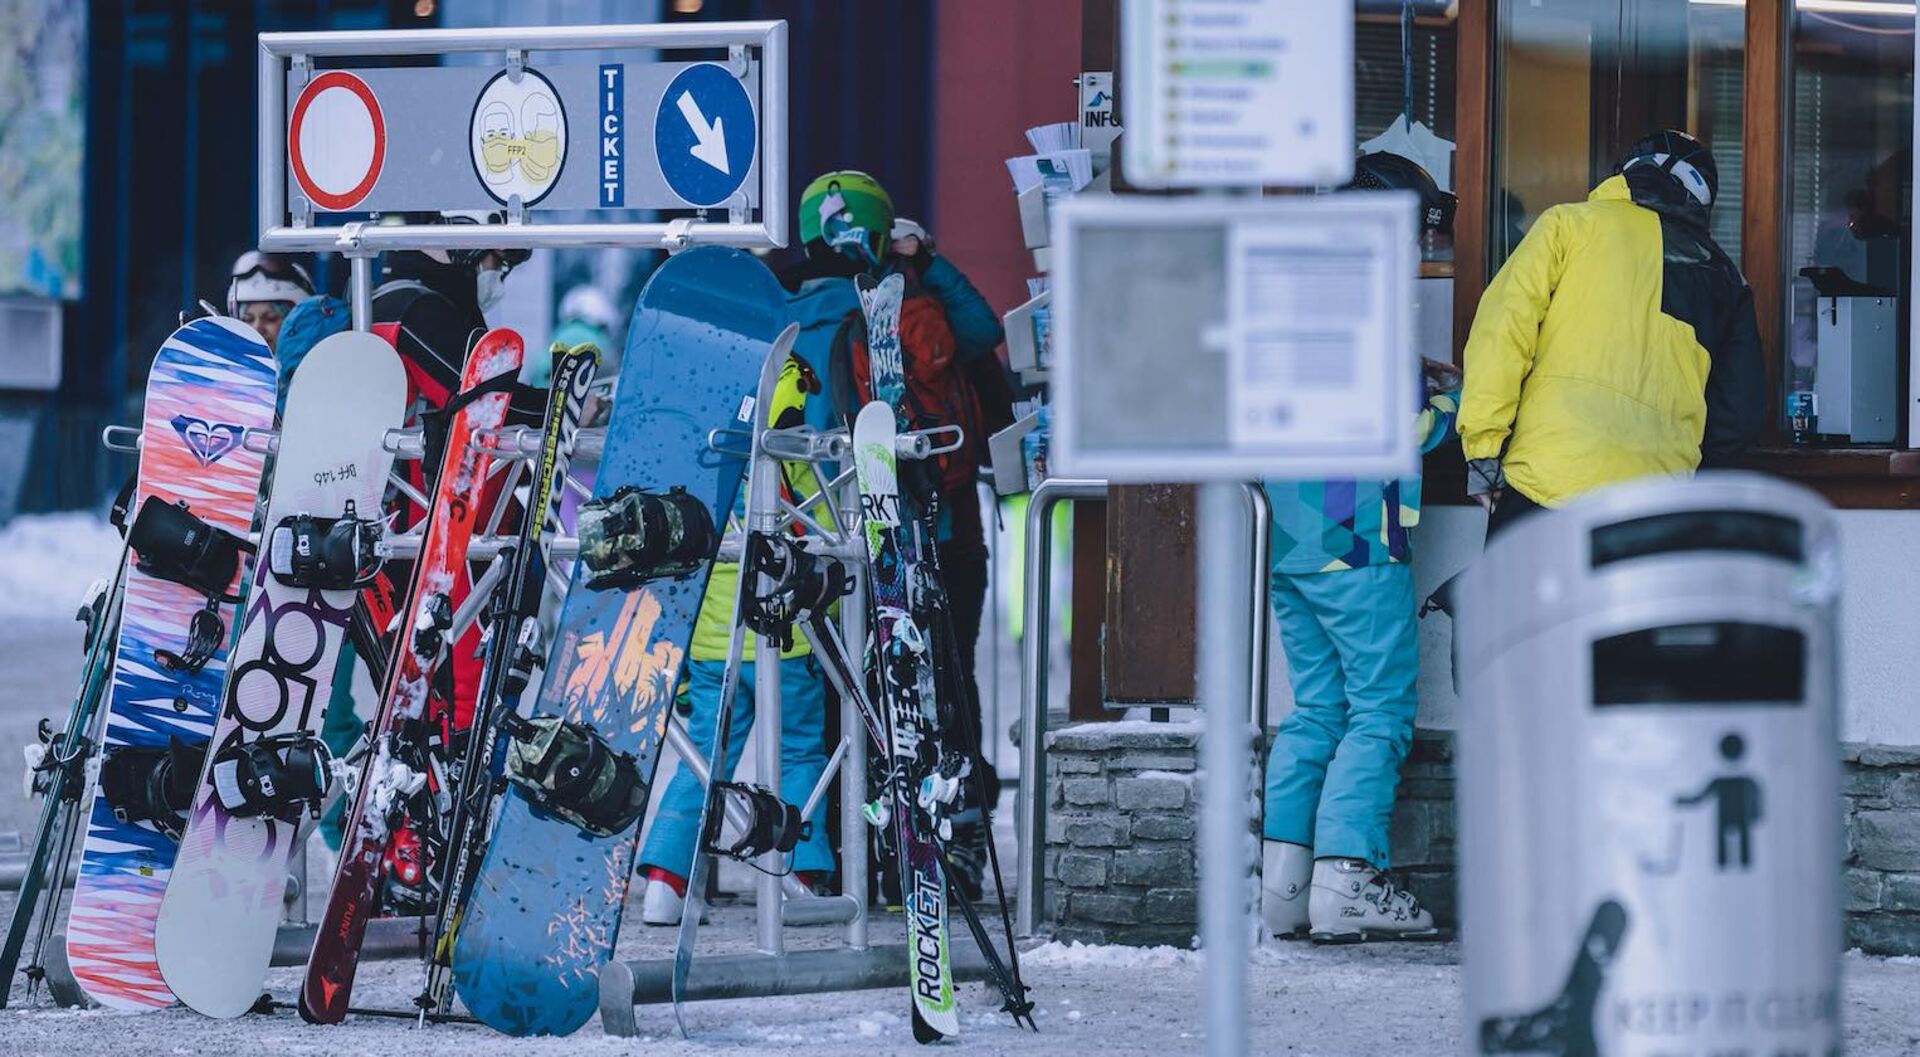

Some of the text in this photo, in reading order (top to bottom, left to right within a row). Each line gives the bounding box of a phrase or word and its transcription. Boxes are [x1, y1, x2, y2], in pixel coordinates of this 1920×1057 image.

[507, 145, 526, 156] FFP2
[604, 69, 620, 202] TICKET
[530, 390, 565, 541] SUPERCROSS
[540, 357, 597, 567] ATOMIC
[860, 494, 901, 521] RKT
[915, 869, 942, 1003] ROCKET
